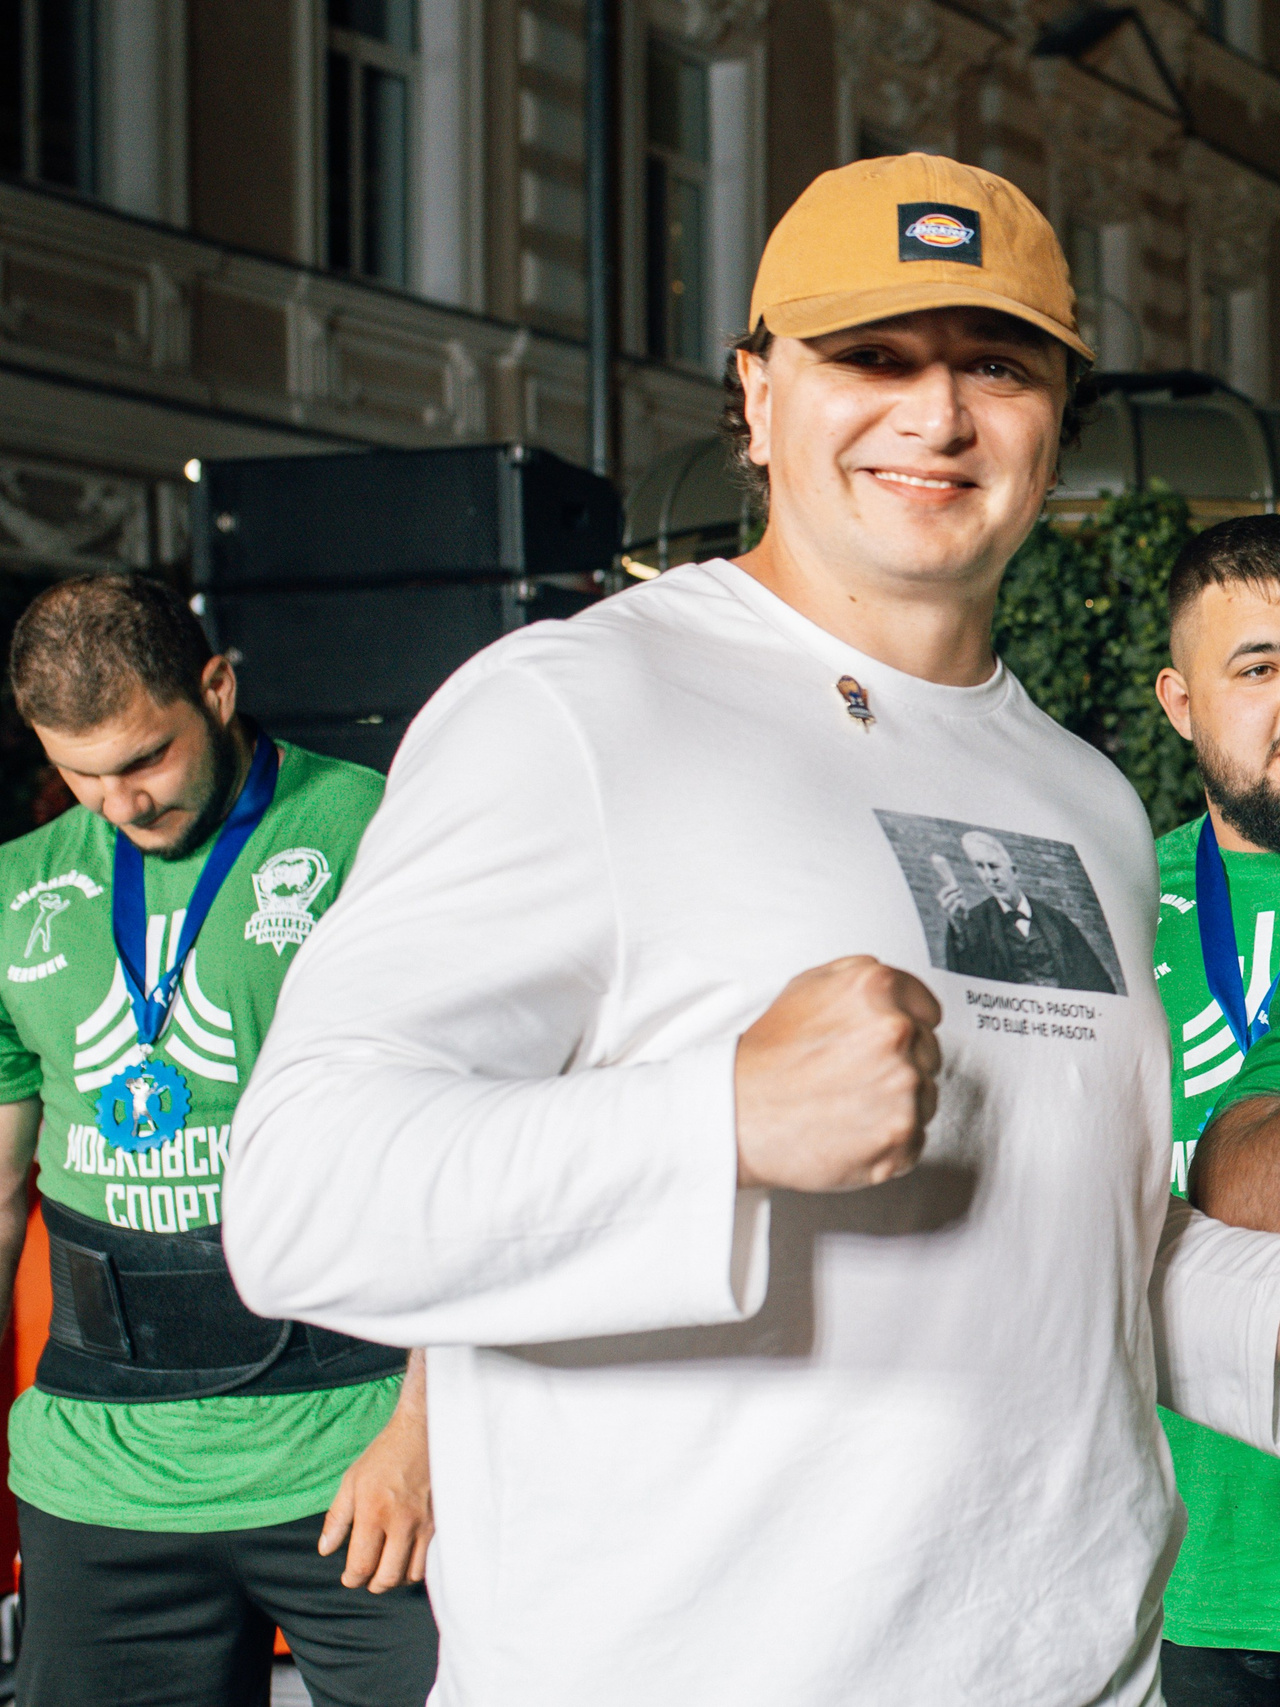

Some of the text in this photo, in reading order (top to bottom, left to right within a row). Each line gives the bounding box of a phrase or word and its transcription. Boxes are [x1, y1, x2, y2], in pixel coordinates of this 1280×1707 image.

[248, 917, 313, 934] НАЦИЯ
[966, 989, 1045, 1015] ВИДИМОСТЬ
[1046, 1001, 1096, 1020] РАБОТЫ
[976, 1013, 1001, 1031] ЭТО
[1031, 1021, 1049, 1037] НЕ
[1051, 1023, 1098, 1041] РАБОТА
[105, 1183, 221, 1234] СПОРТ
